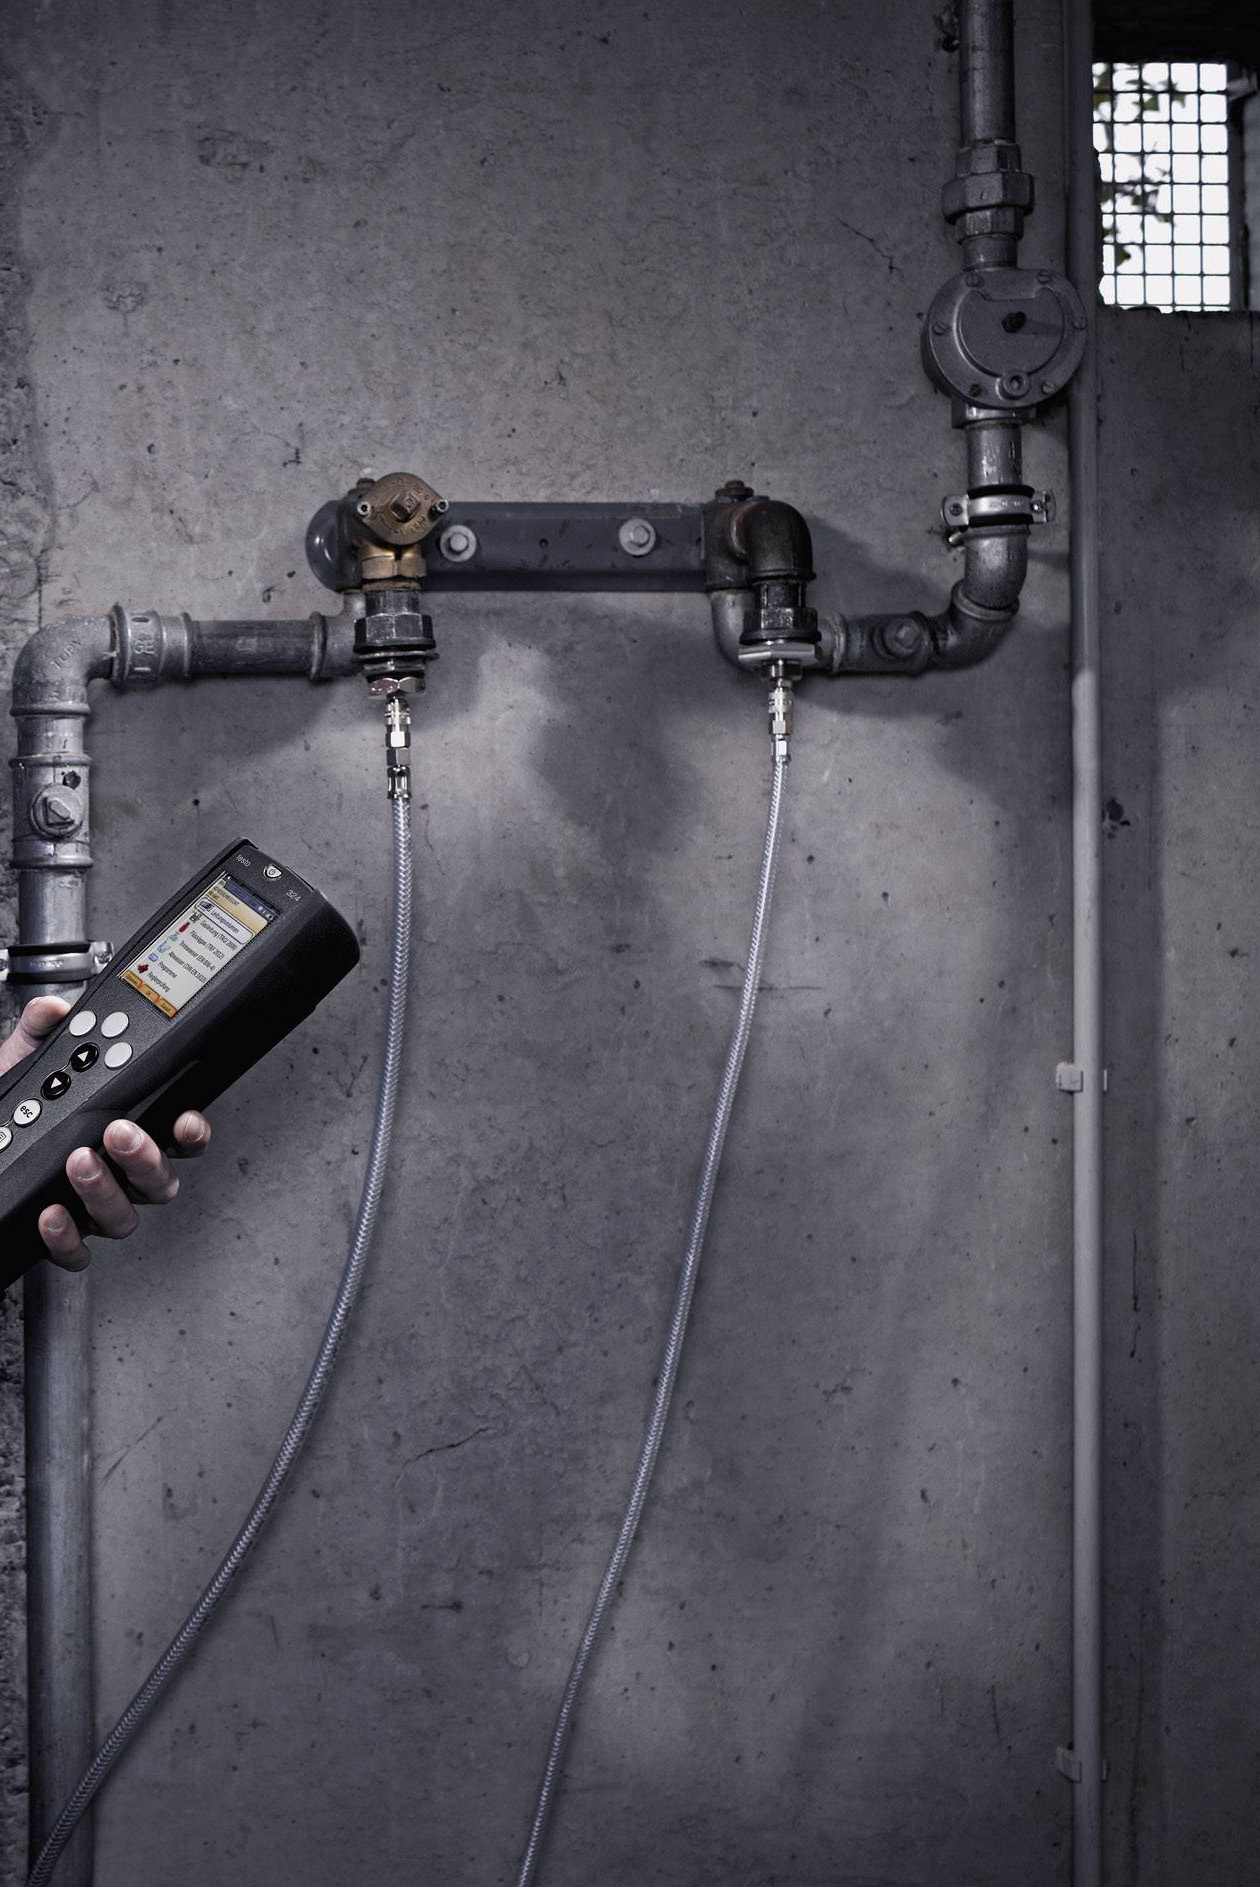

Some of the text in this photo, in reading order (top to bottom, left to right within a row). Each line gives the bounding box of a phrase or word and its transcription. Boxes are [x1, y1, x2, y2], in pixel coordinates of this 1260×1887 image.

[236, 854, 250, 867] testo
[286, 889, 301, 902] 324
[20, 1104, 34, 1118] esc
